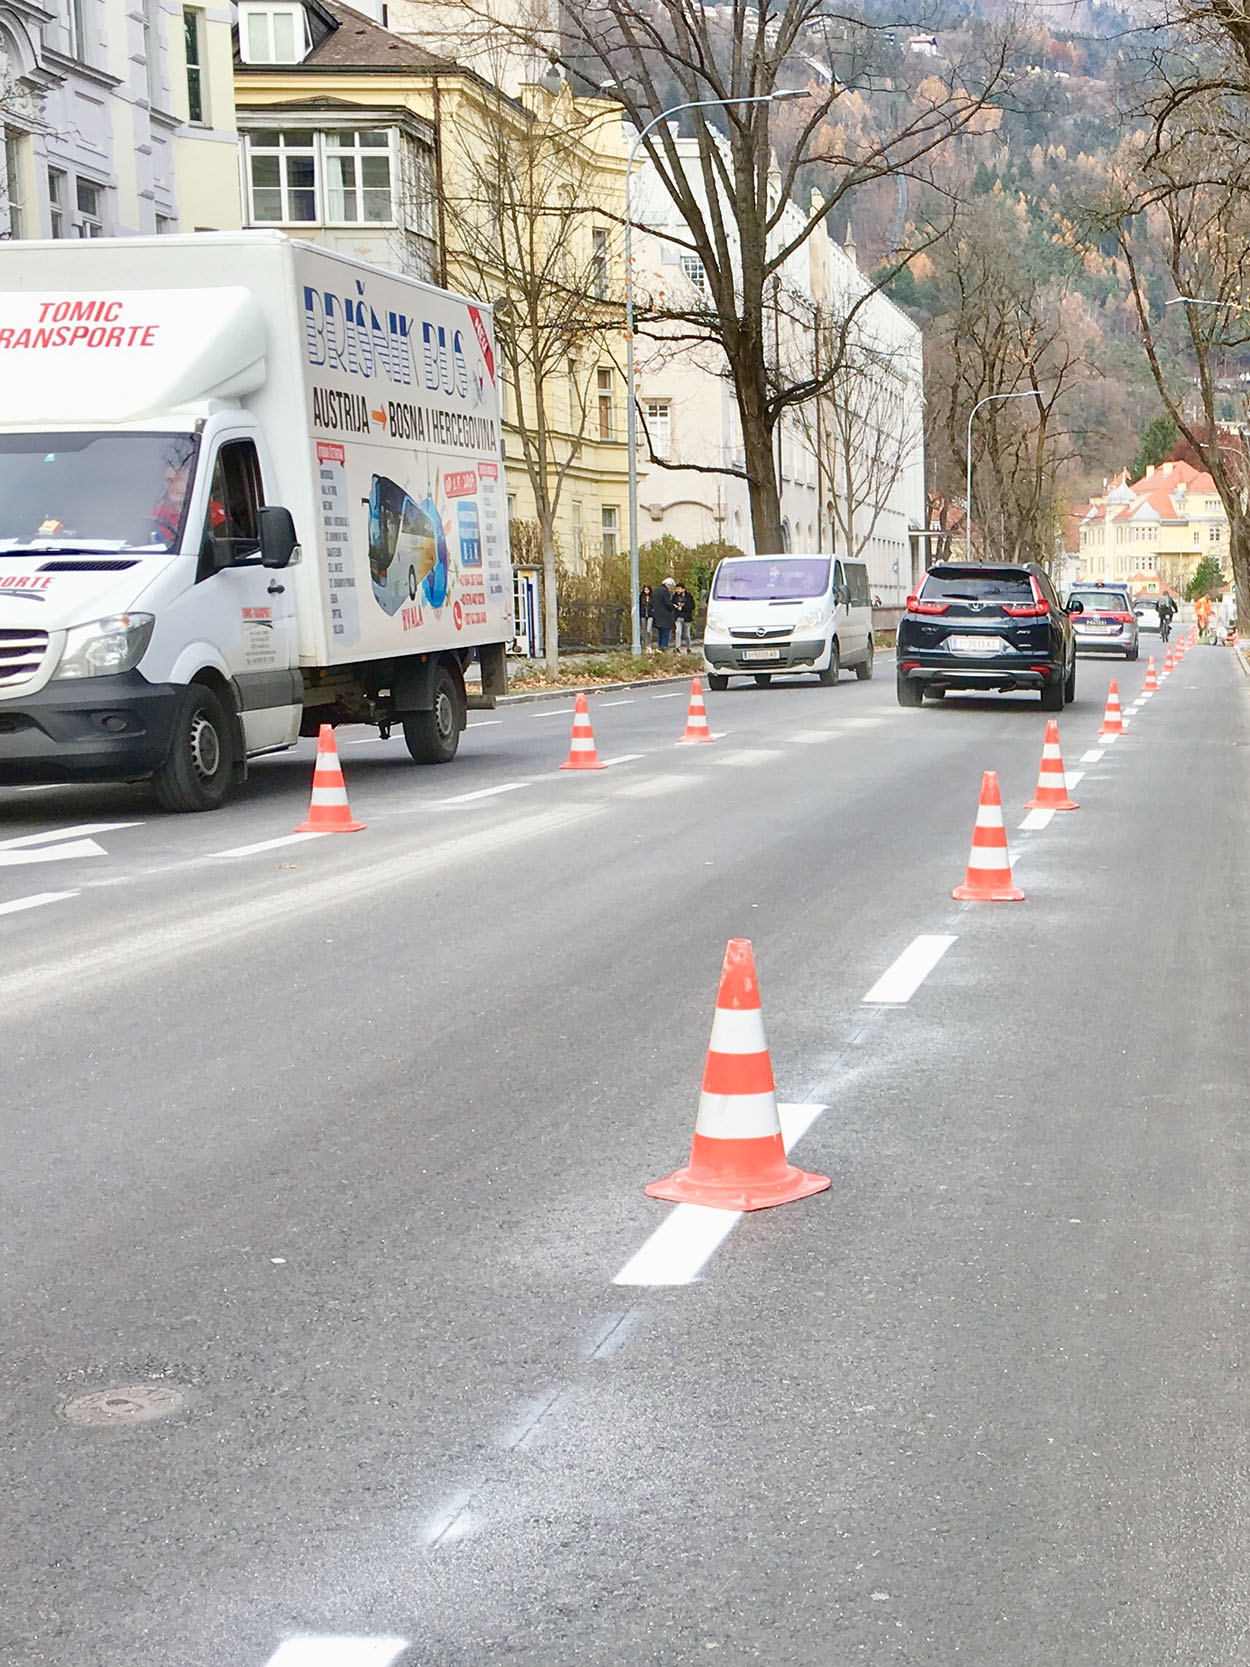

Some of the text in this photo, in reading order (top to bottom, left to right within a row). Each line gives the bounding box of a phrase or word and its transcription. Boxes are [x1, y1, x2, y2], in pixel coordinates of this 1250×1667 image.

[38, 301, 123, 323] TOMIC
[422, 320, 468, 398] BUS
[312, 387, 497, 452] AUSTRIJA BOSNA I HERCEGOVINA
